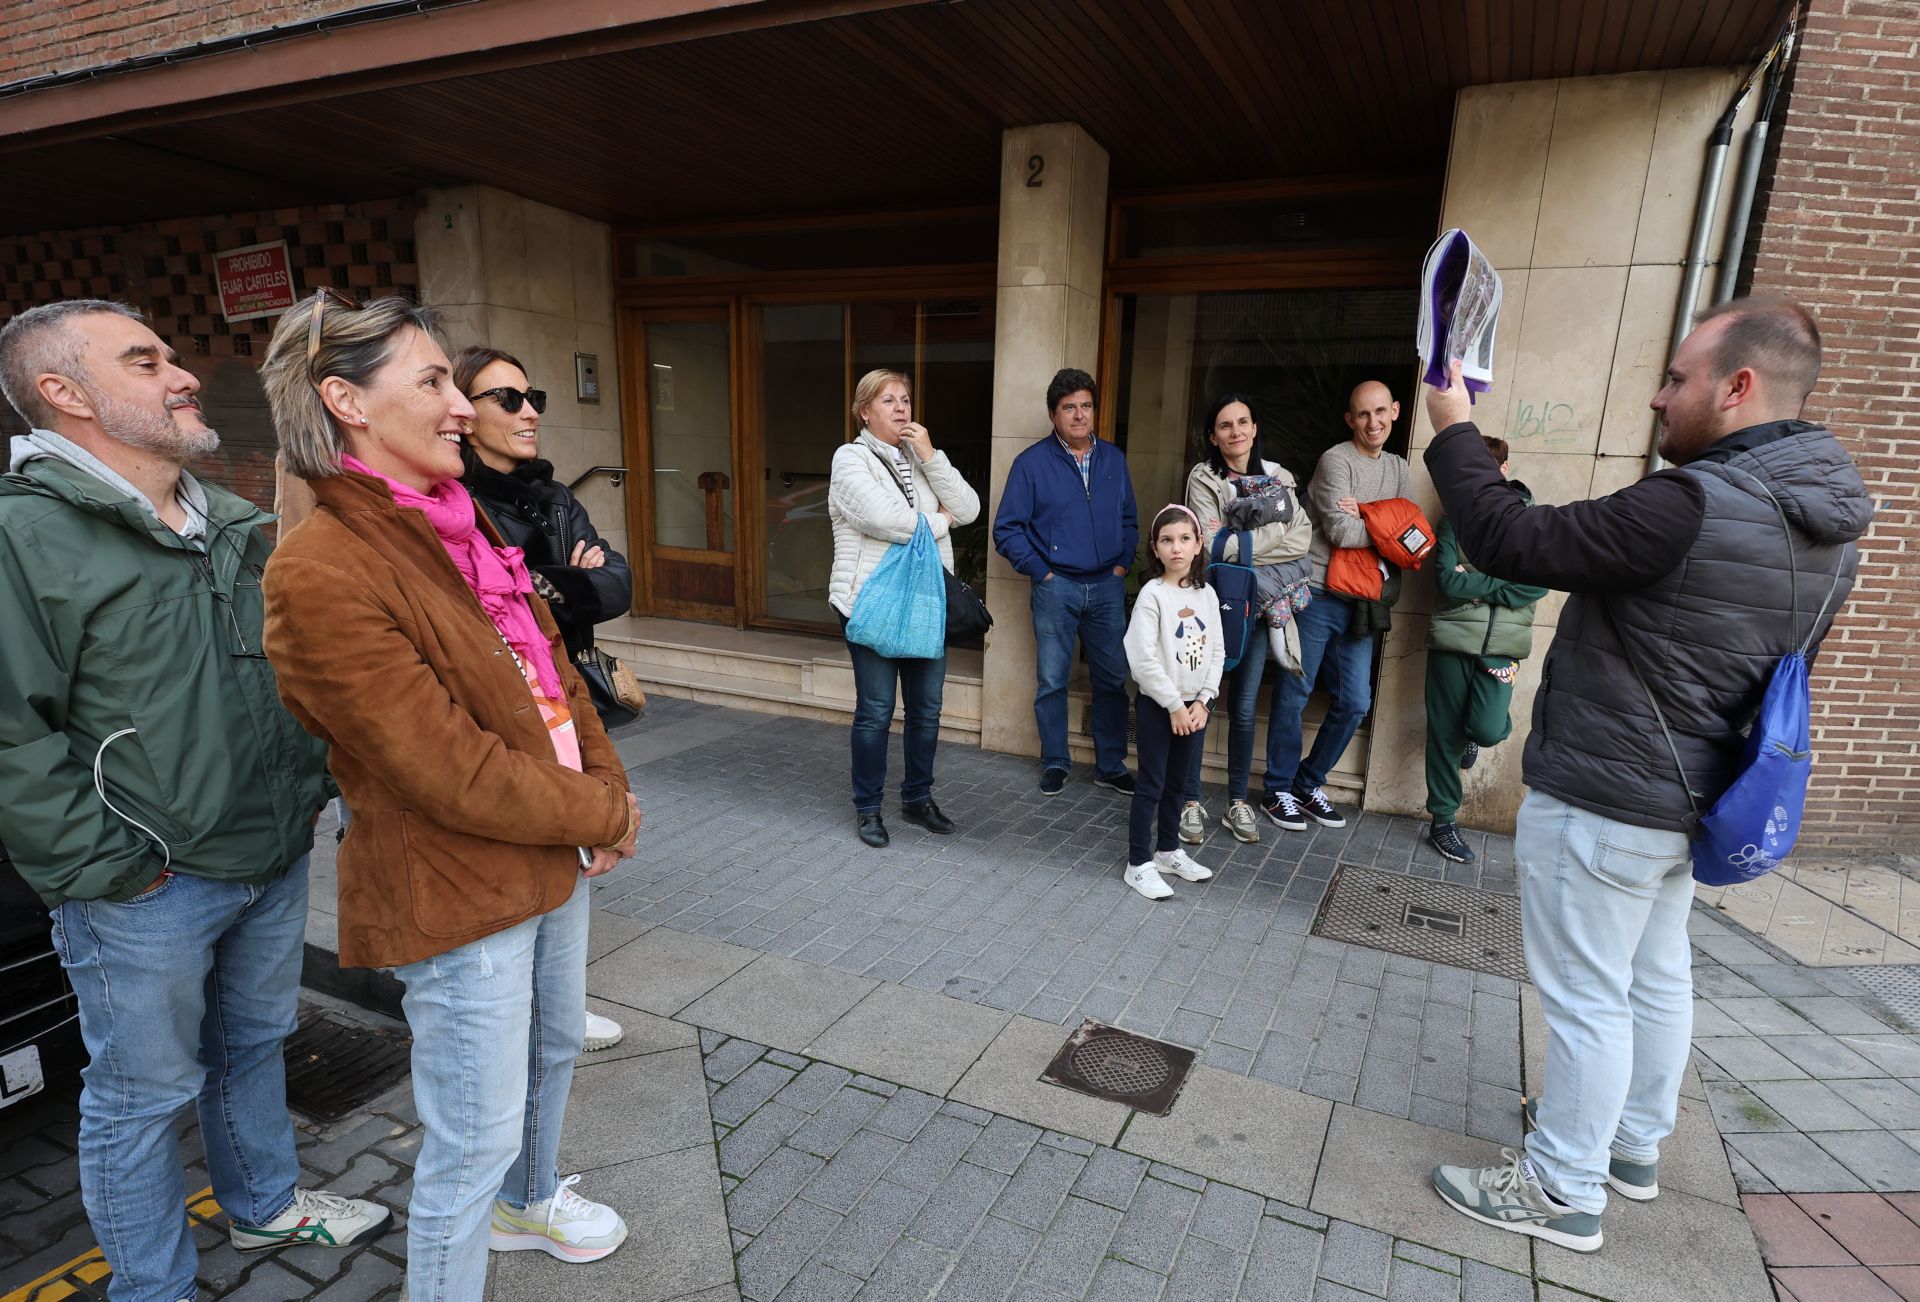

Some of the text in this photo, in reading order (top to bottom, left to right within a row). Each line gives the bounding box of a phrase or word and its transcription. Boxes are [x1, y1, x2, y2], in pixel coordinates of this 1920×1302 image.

[1026, 154, 1045, 188] 2
[228, 252, 272, 273] PROHIBIDO
[221, 270, 287, 296] FIJAR CARTELES
